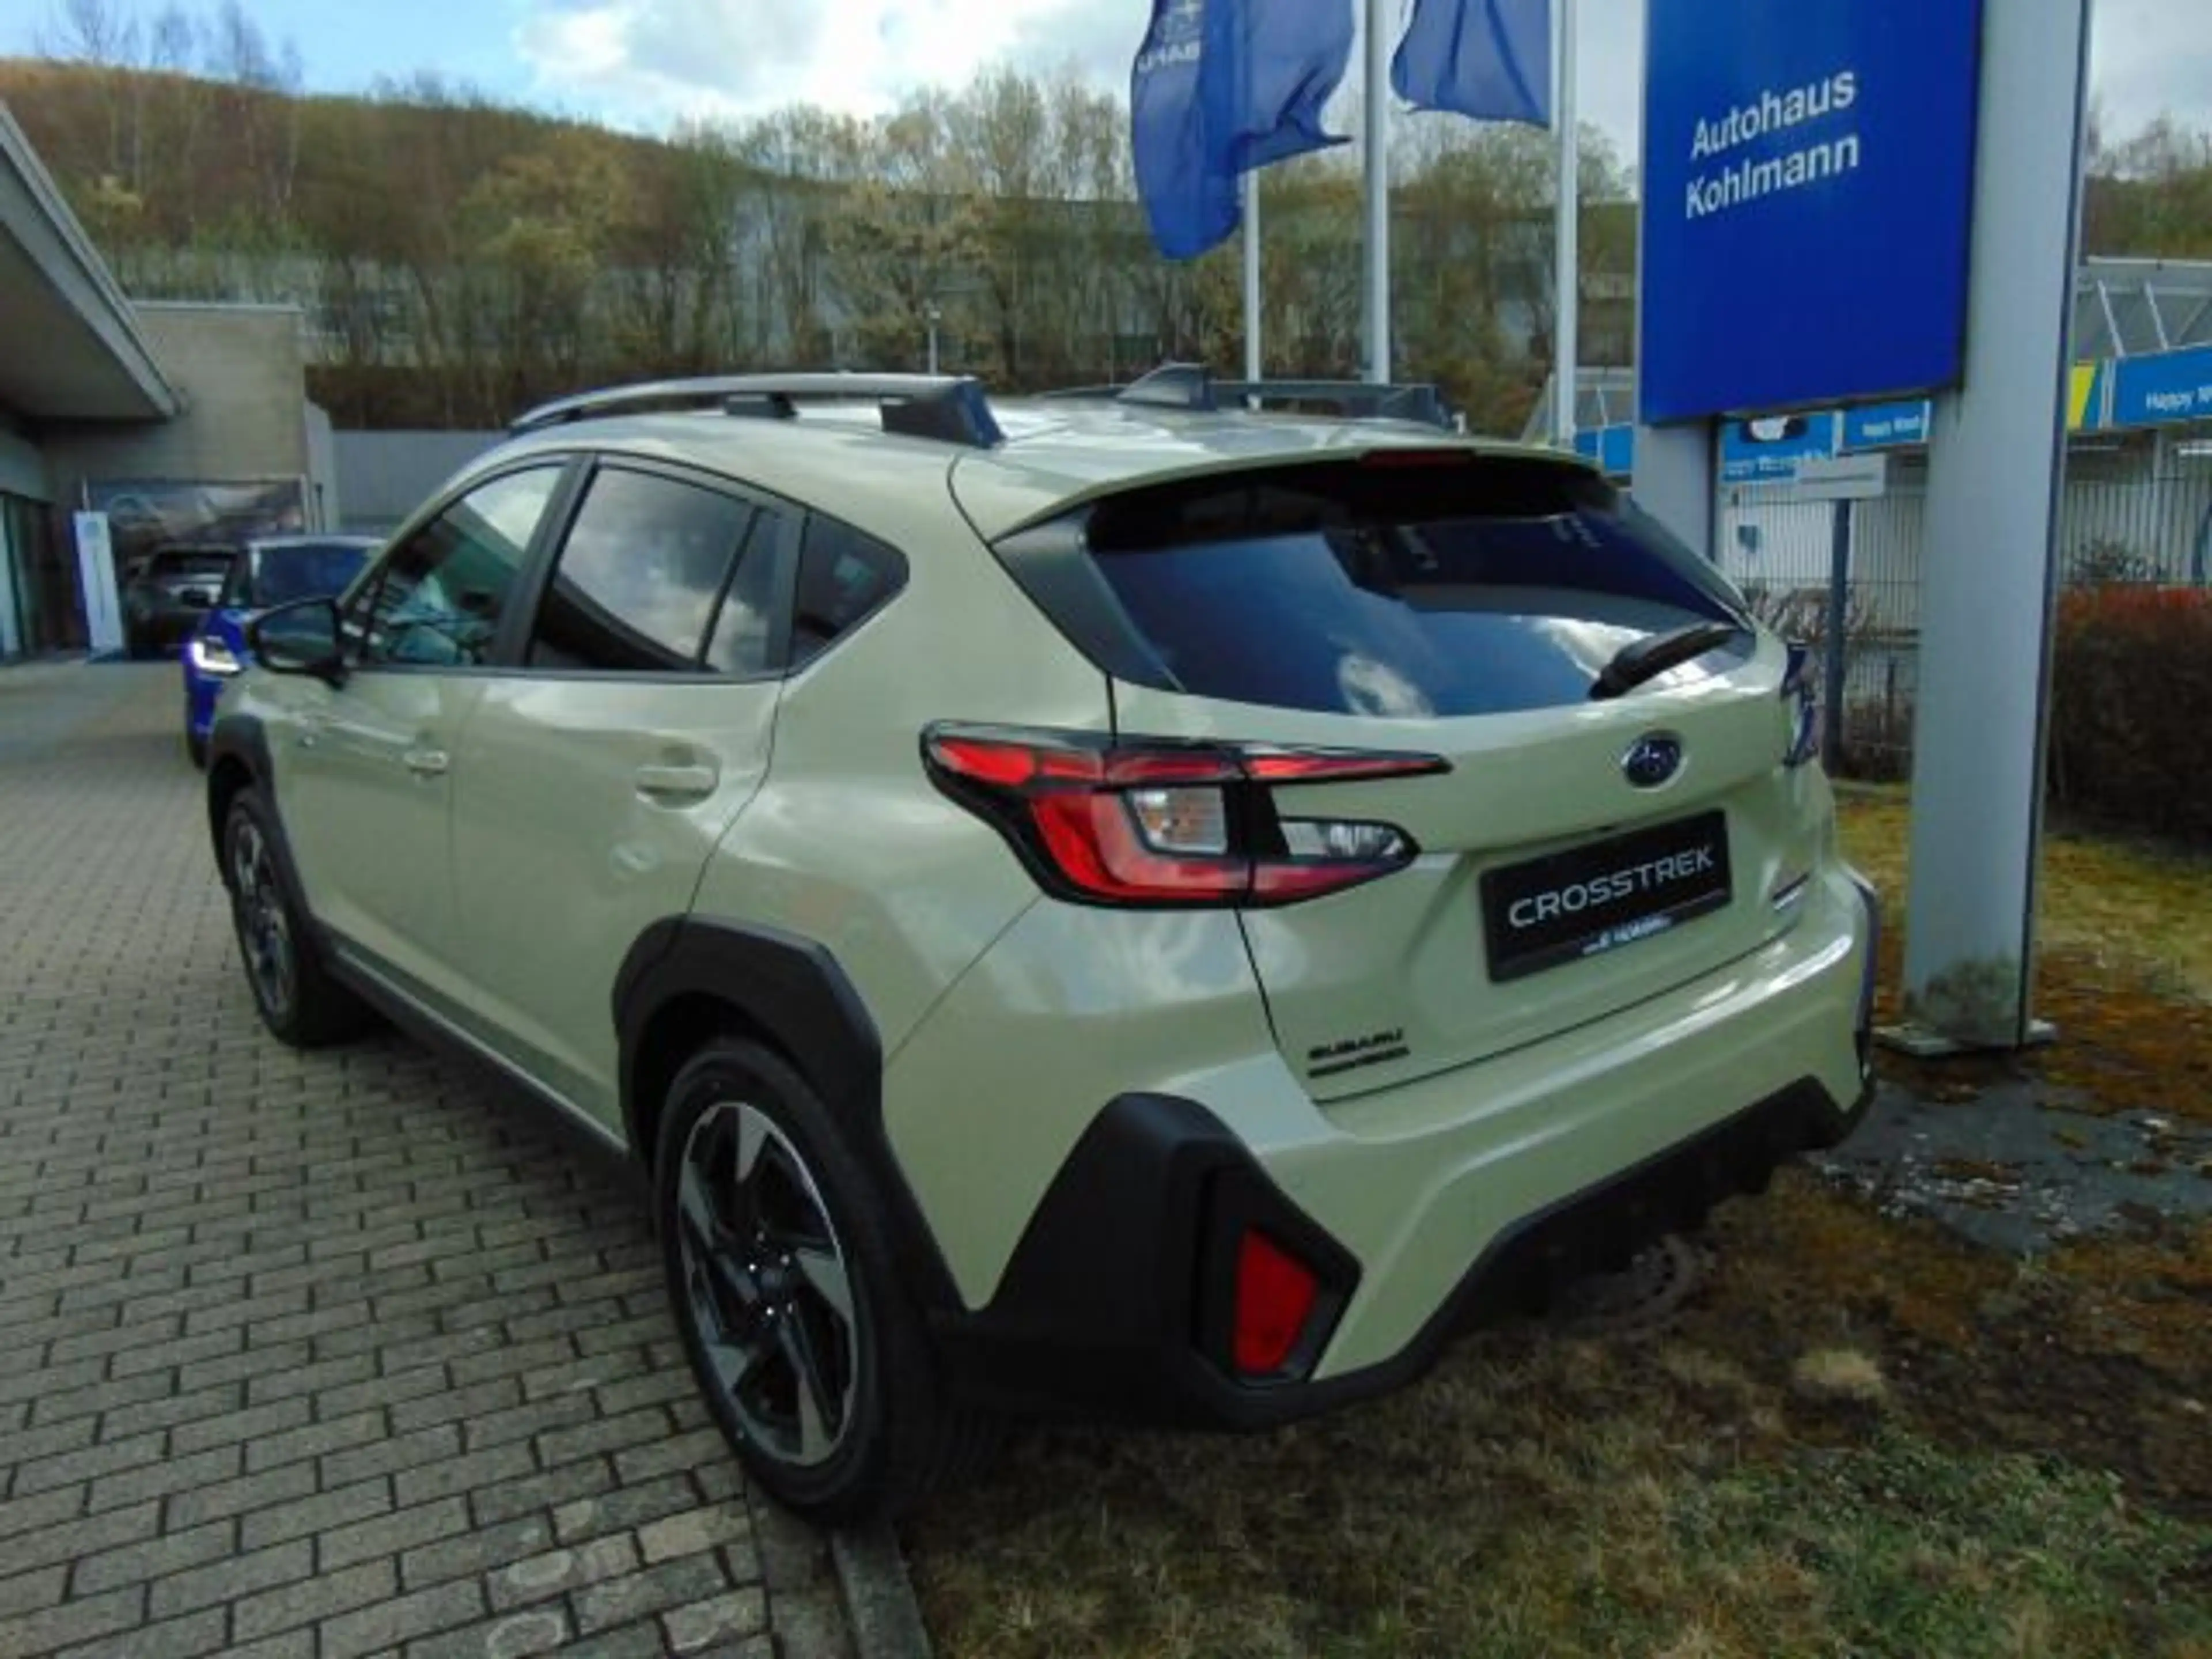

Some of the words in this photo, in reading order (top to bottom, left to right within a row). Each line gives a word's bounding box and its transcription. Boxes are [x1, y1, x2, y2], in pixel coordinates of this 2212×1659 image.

[1690, 70, 1855, 161] Autohaus
[1685, 134, 1859, 220] Kohlmann
[1509, 844, 1714, 928] CROSSTREK
